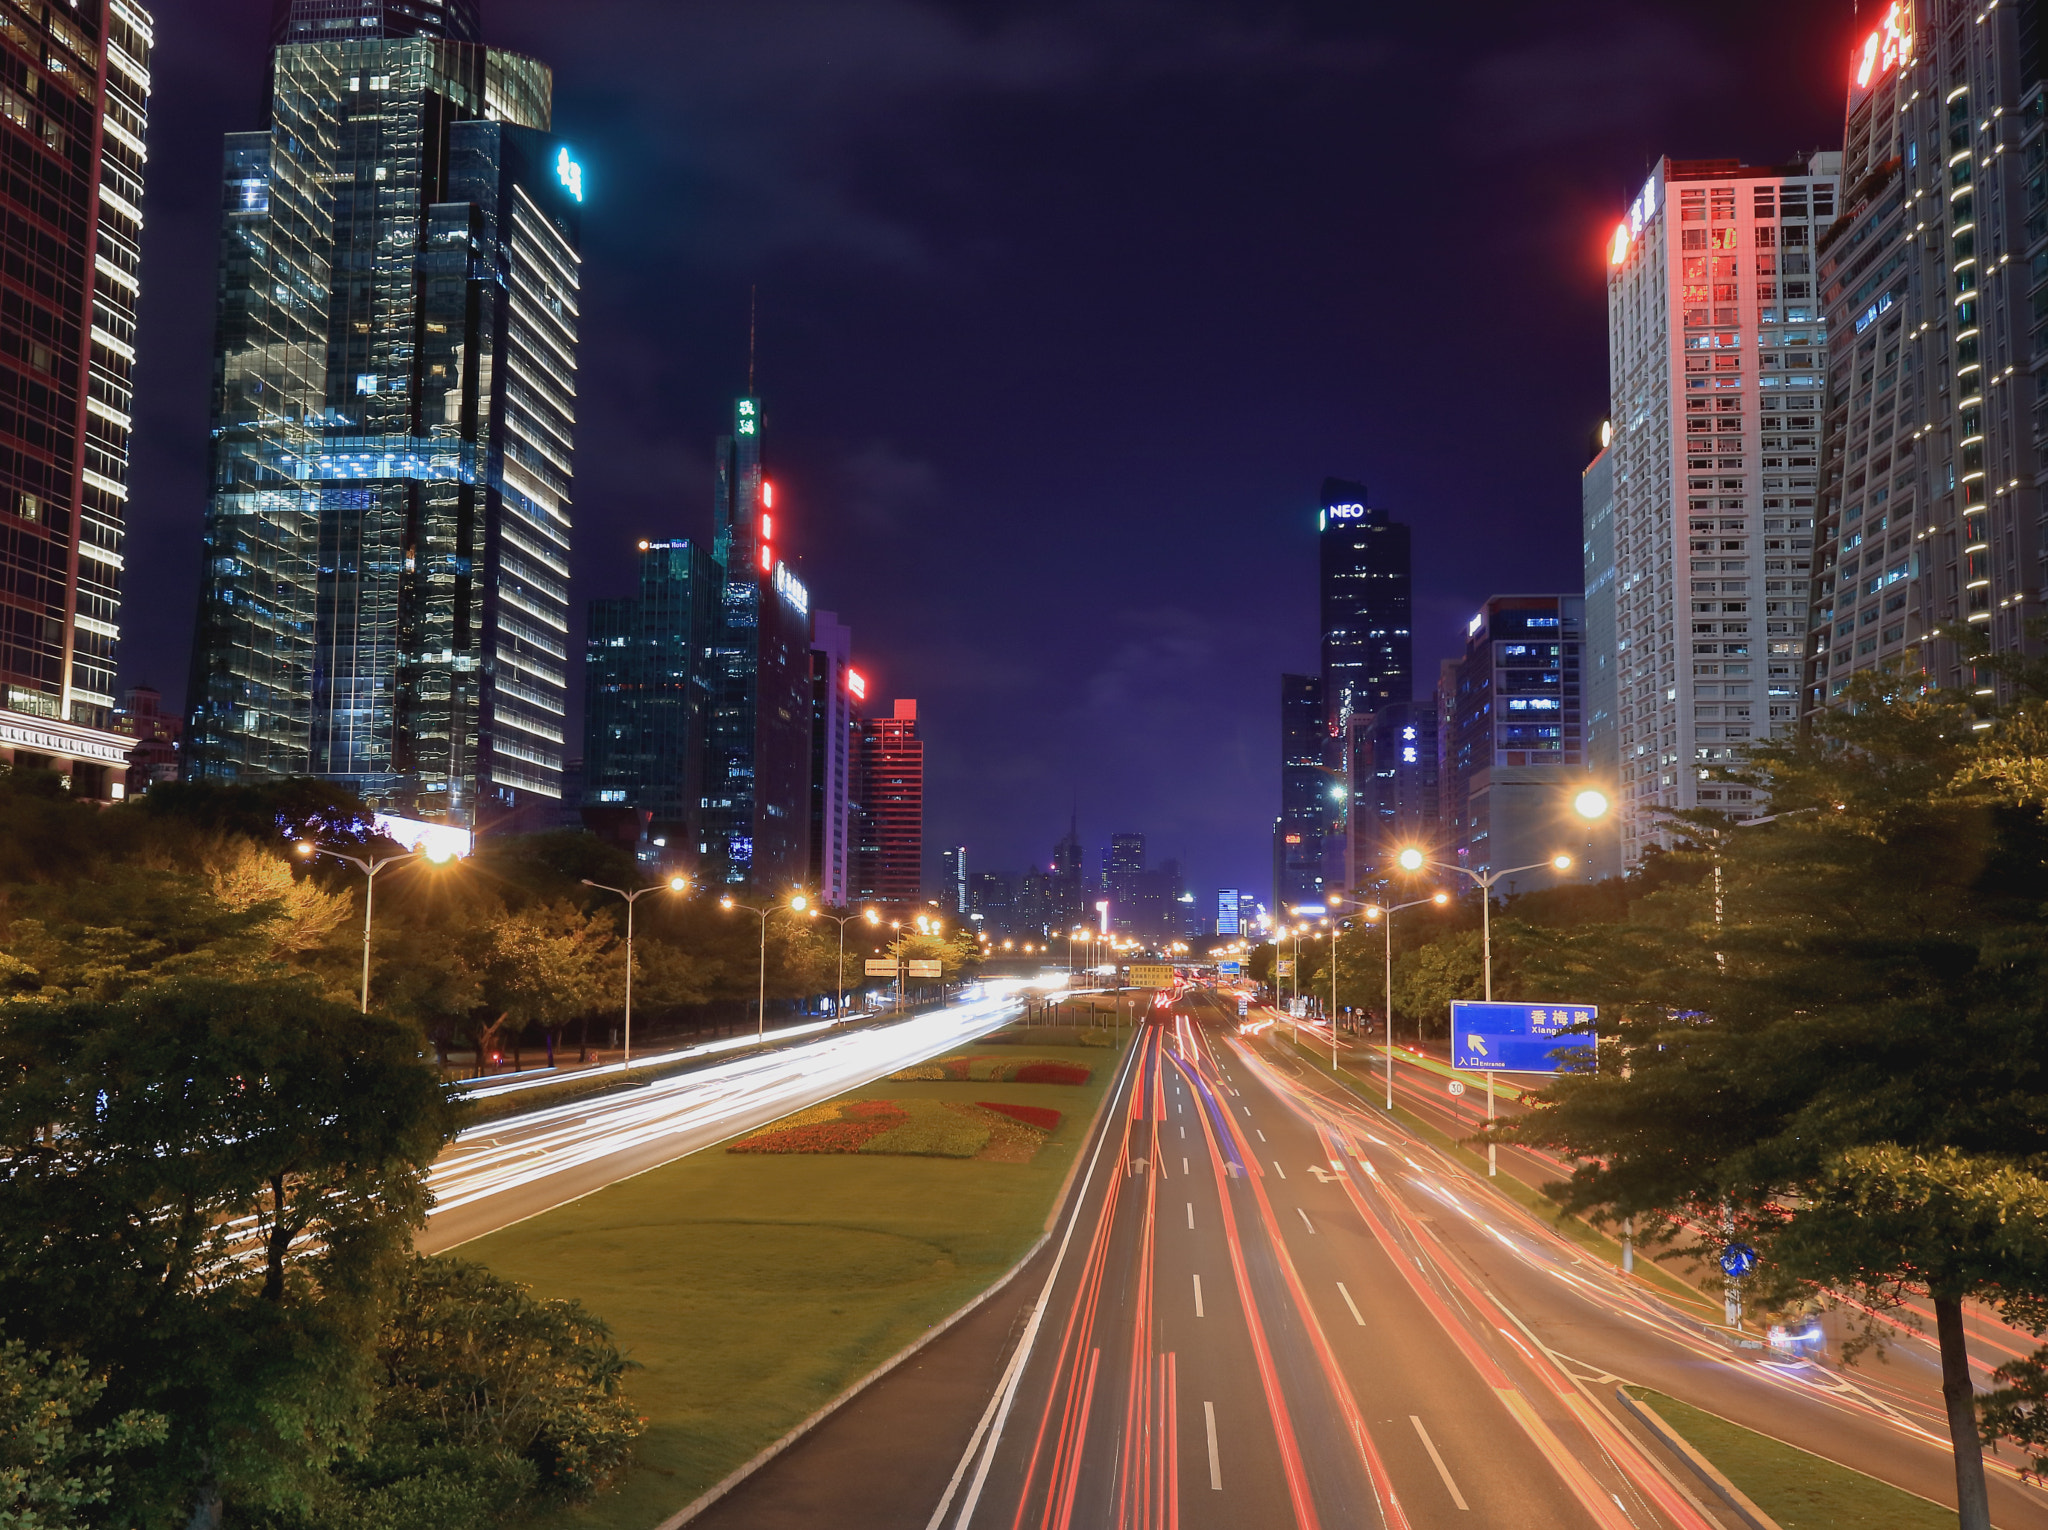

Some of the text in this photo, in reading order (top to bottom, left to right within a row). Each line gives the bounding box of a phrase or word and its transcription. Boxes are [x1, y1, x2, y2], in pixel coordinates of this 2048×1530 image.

[1330, 503, 1364, 518] NEO
[1531, 1009, 1590, 1026] 香梅路
[1458, 1056, 1479, 1066] 入口
[1451, 1083, 1462, 1093] 30
